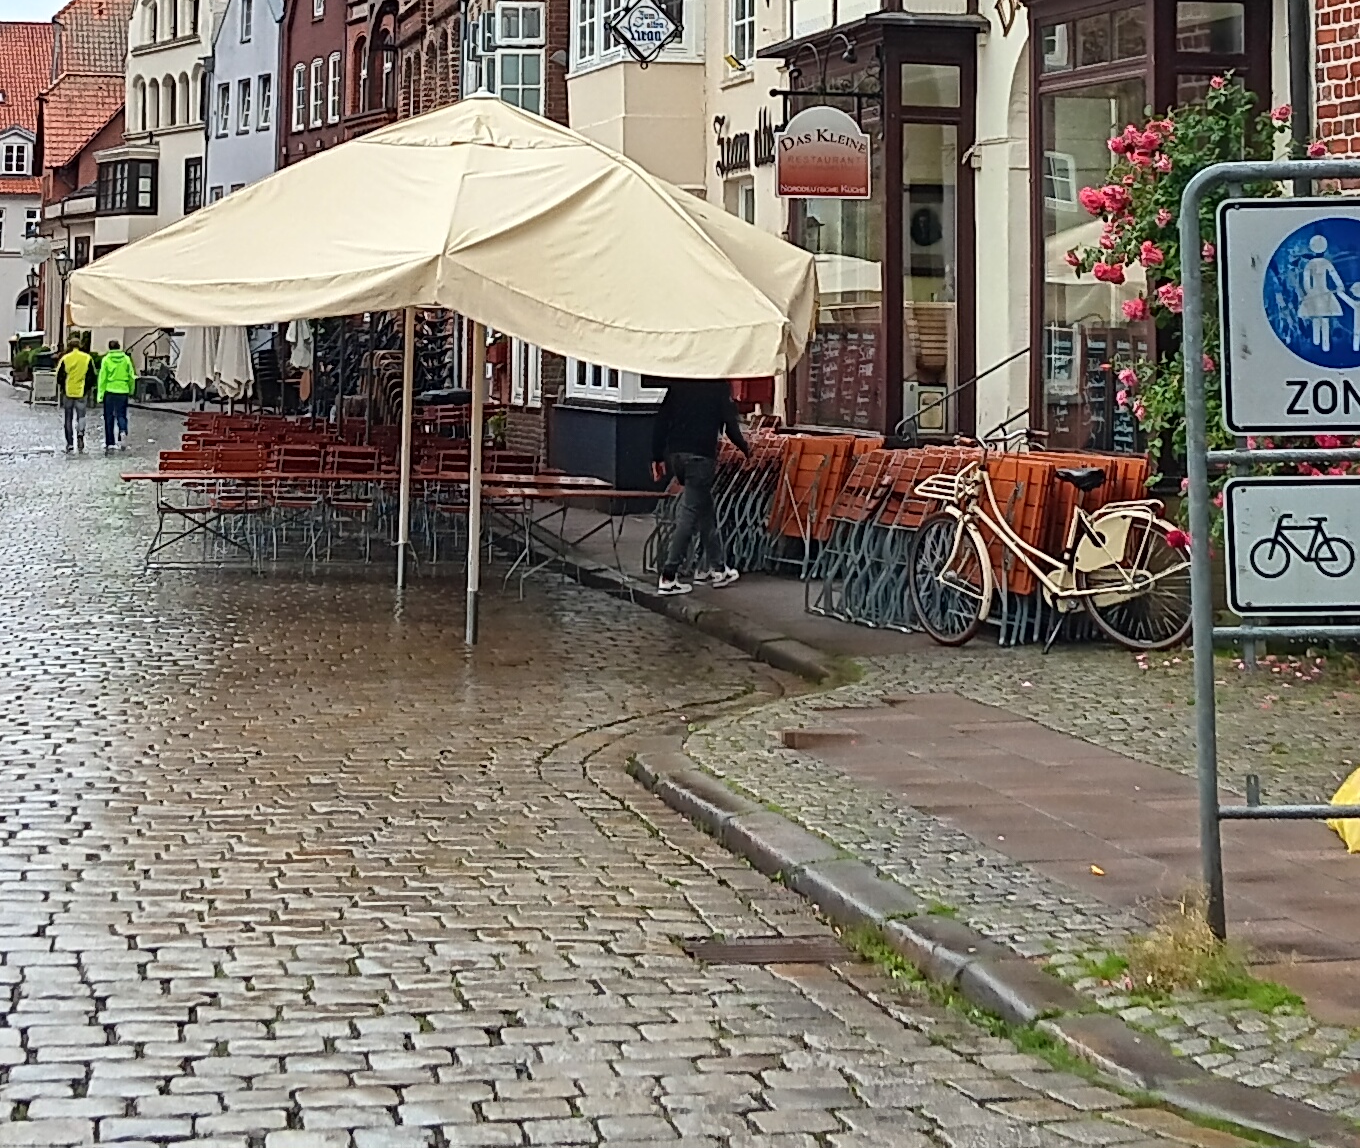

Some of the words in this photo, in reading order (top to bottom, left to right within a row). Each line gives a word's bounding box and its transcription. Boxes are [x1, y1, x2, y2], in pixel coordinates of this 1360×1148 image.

[781, 133, 812, 151] DAS
[815, 128, 867, 154] KLEINE
[787, 155, 862, 164] RESTAURANT
